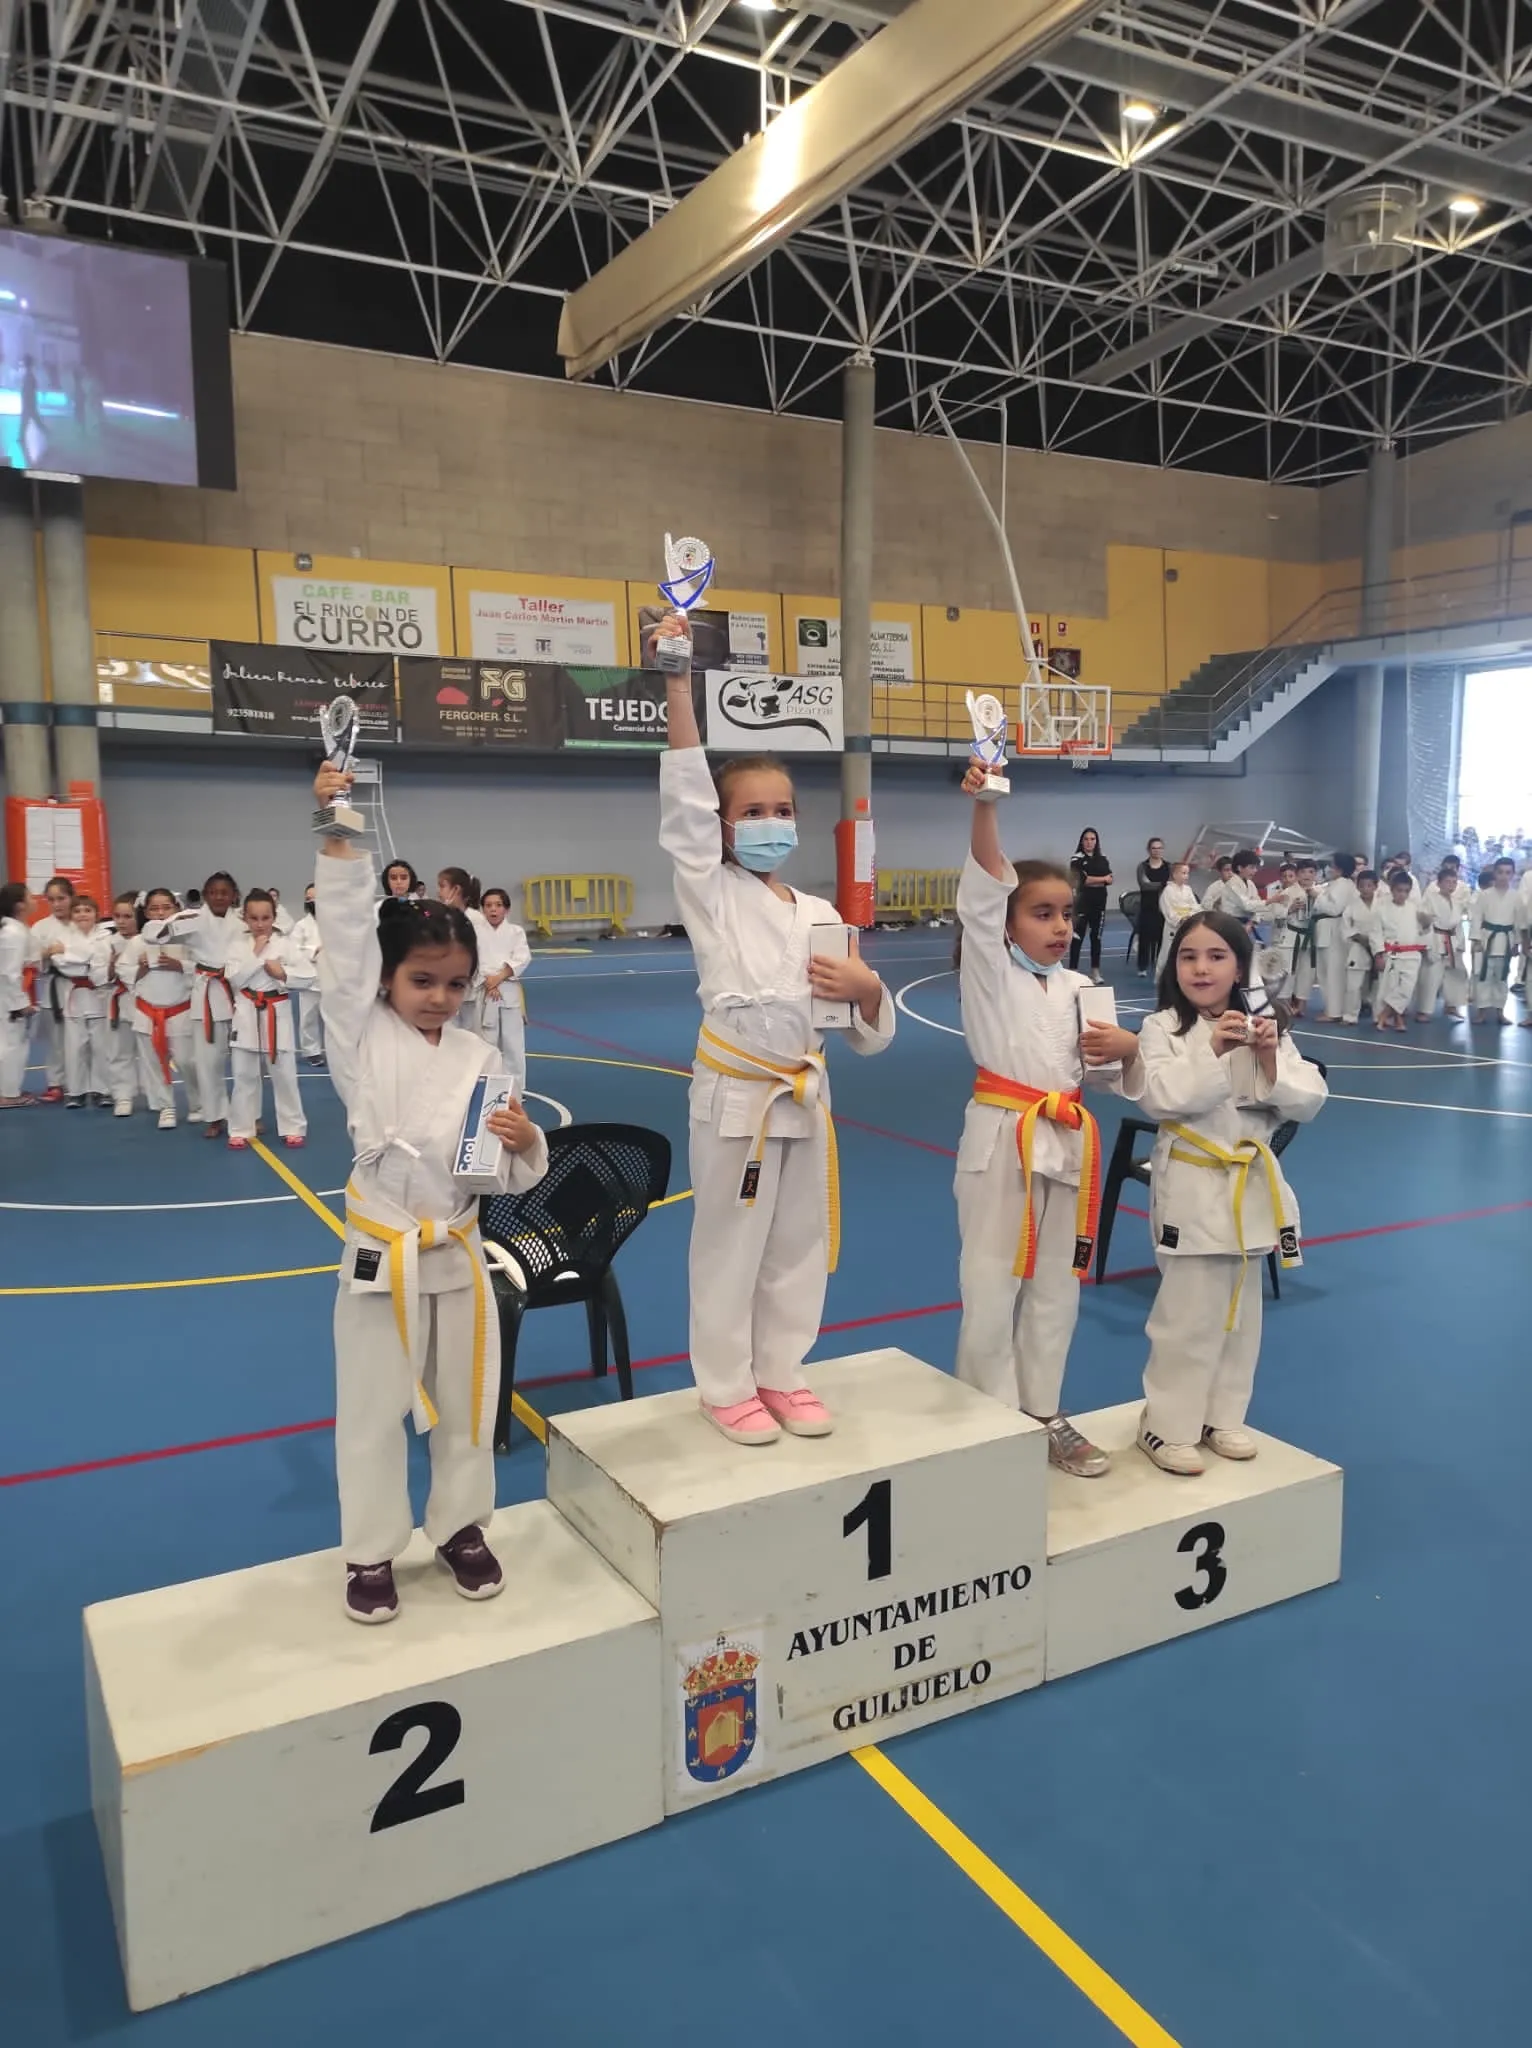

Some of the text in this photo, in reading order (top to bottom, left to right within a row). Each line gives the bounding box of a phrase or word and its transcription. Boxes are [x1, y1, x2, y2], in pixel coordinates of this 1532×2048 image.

[293, 601, 317, 616] EL
[395, 608, 418, 622] DE
[371, 589, 410, 604] BAR
[518, 597, 565, 613] Taller
[293, 615, 422, 649] CURRO
[786, 684, 833, 705] ASG
[843, 1479, 891, 1581] 1
[1174, 1521, 1227, 1610] 3
[786, 1564, 1032, 1661] AYUNTAMIENTO
[893, 1634, 937, 1671] DE
[833, 1660, 991, 1731] GUIJUELO
[368, 1701, 465, 1834] 2
